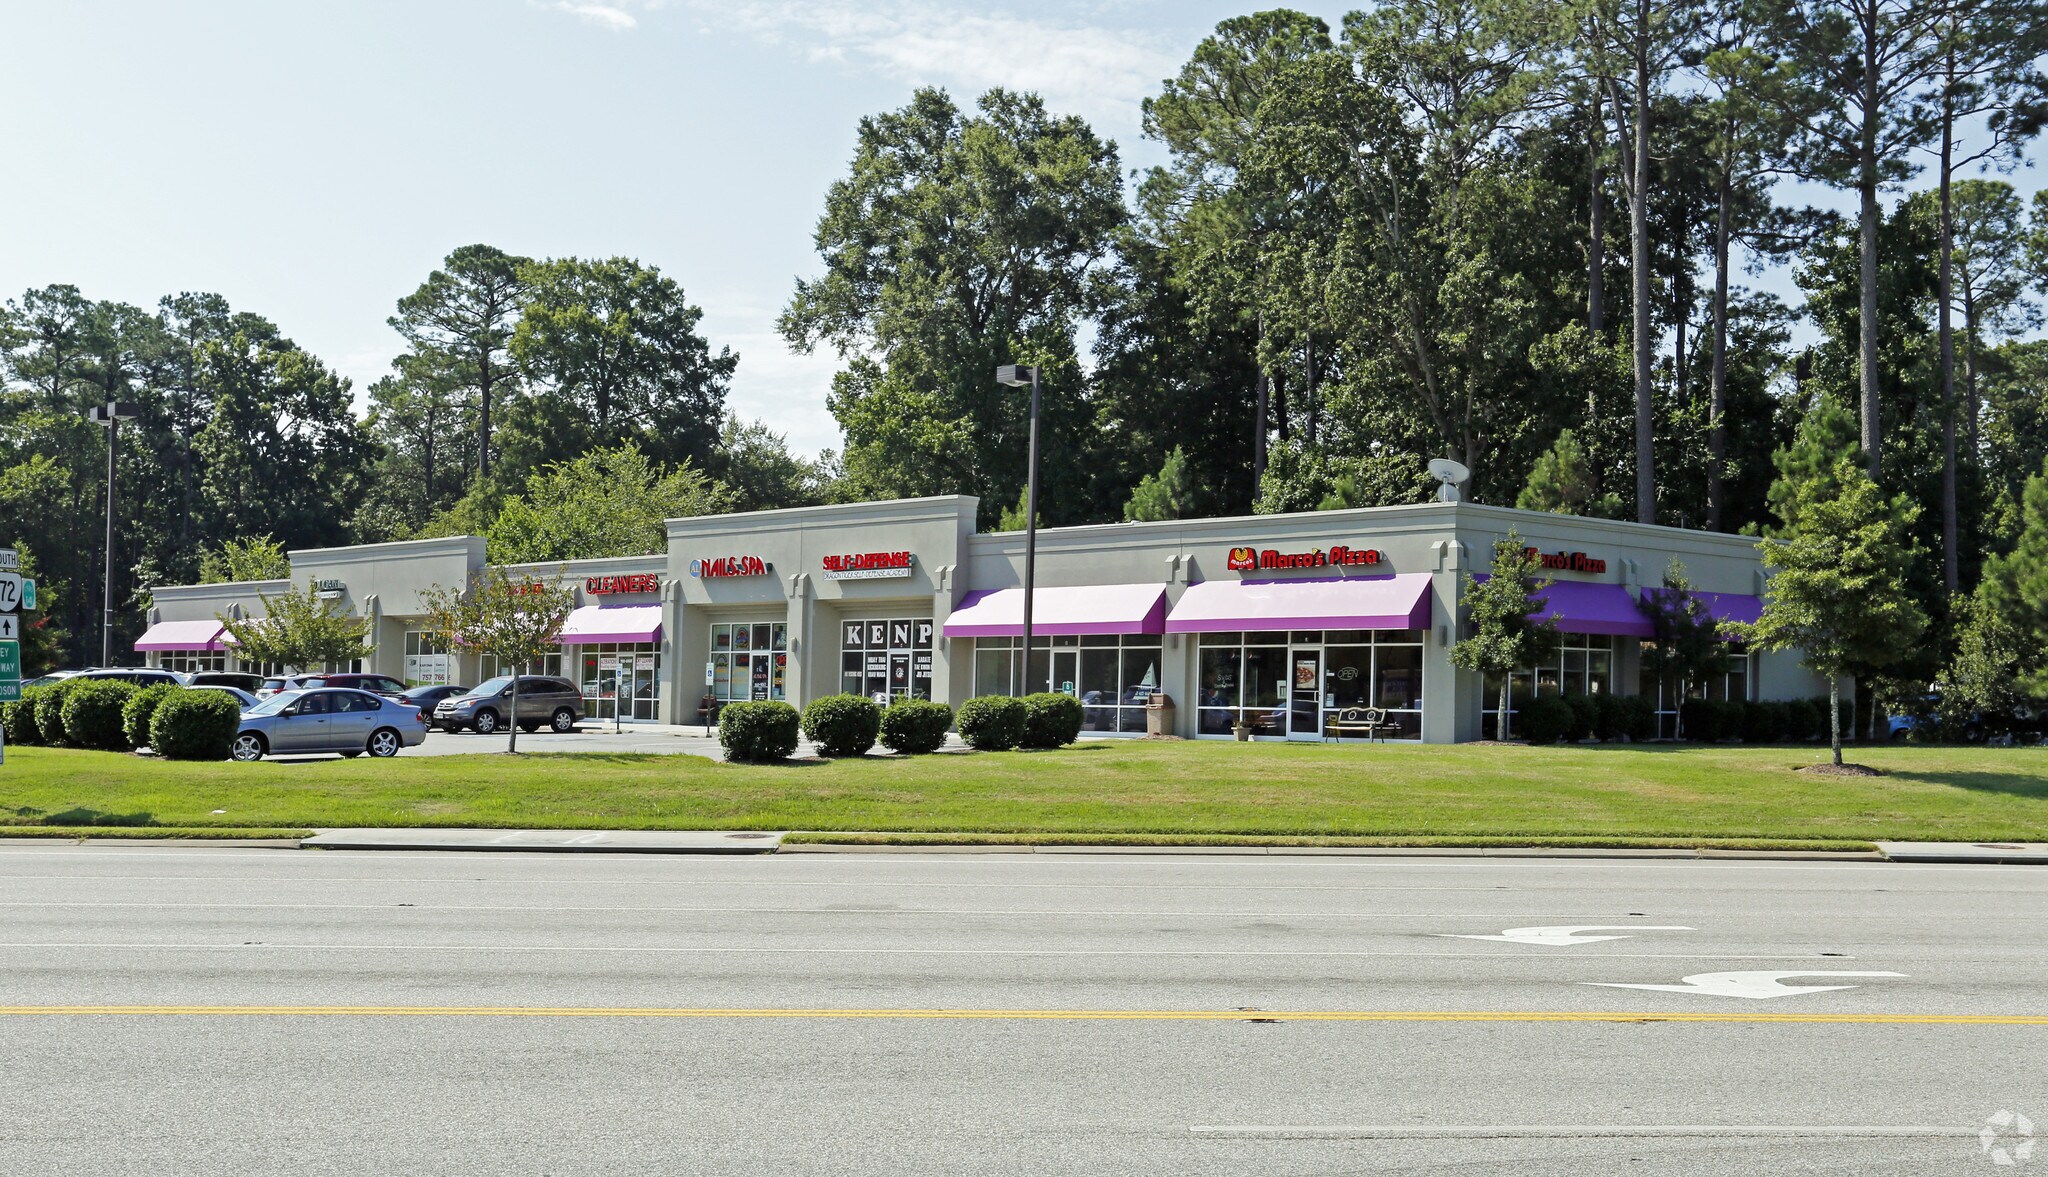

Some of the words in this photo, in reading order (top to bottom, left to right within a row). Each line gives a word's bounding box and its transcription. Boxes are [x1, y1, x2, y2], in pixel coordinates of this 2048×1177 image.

[823, 552, 910, 570] SELF-DEFENSE
[1261, 549, 1325, 569] Marco's
[1329, 546, 1379, 566] Pizza
[1575, 552, 1606, 573] Pizza
[0, 581, 15, 602] 72
[586, 573, 658, 595] CLEANERS
